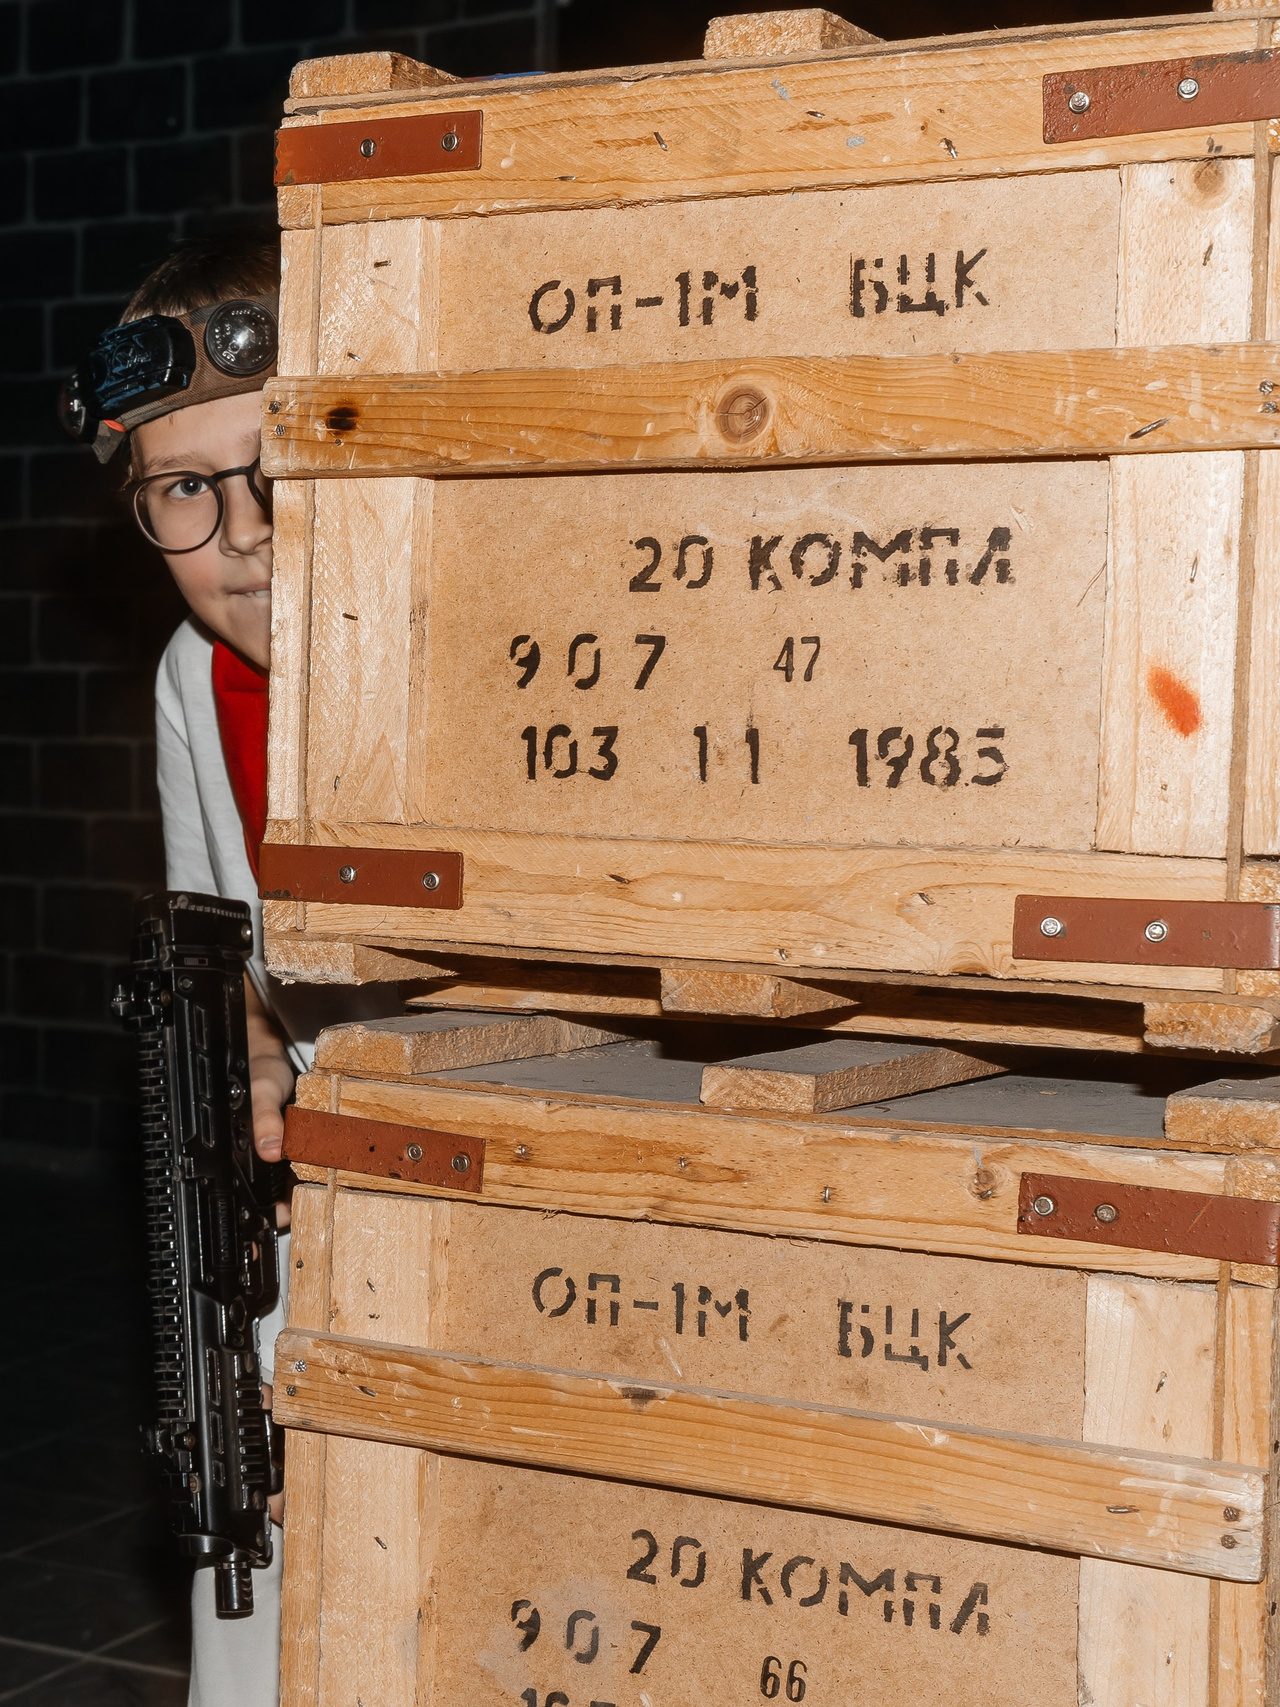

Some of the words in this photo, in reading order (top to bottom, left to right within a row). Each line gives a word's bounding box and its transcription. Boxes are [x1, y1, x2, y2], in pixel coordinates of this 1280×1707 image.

[528, 265, 759, 334] ОП-1М
[849, 247, 991, 318] БЦК
[628, 533, 714, 593] 20
[748, 526, 1016, 593] КОМПЛ
[772, 635, 821, 683] 47
[520, 723, 619, 782] 103
[847, 723, 1010, 788] 1985
[531, 1266, 751, 1342] ОП-1М
[837, 1298, 973, 1372] БЦК
[626, 1528, 708, 1588] 20
[741, 1547, 991, 1637] КОМПЛ
[759, 1655, 808, 1702] 66
